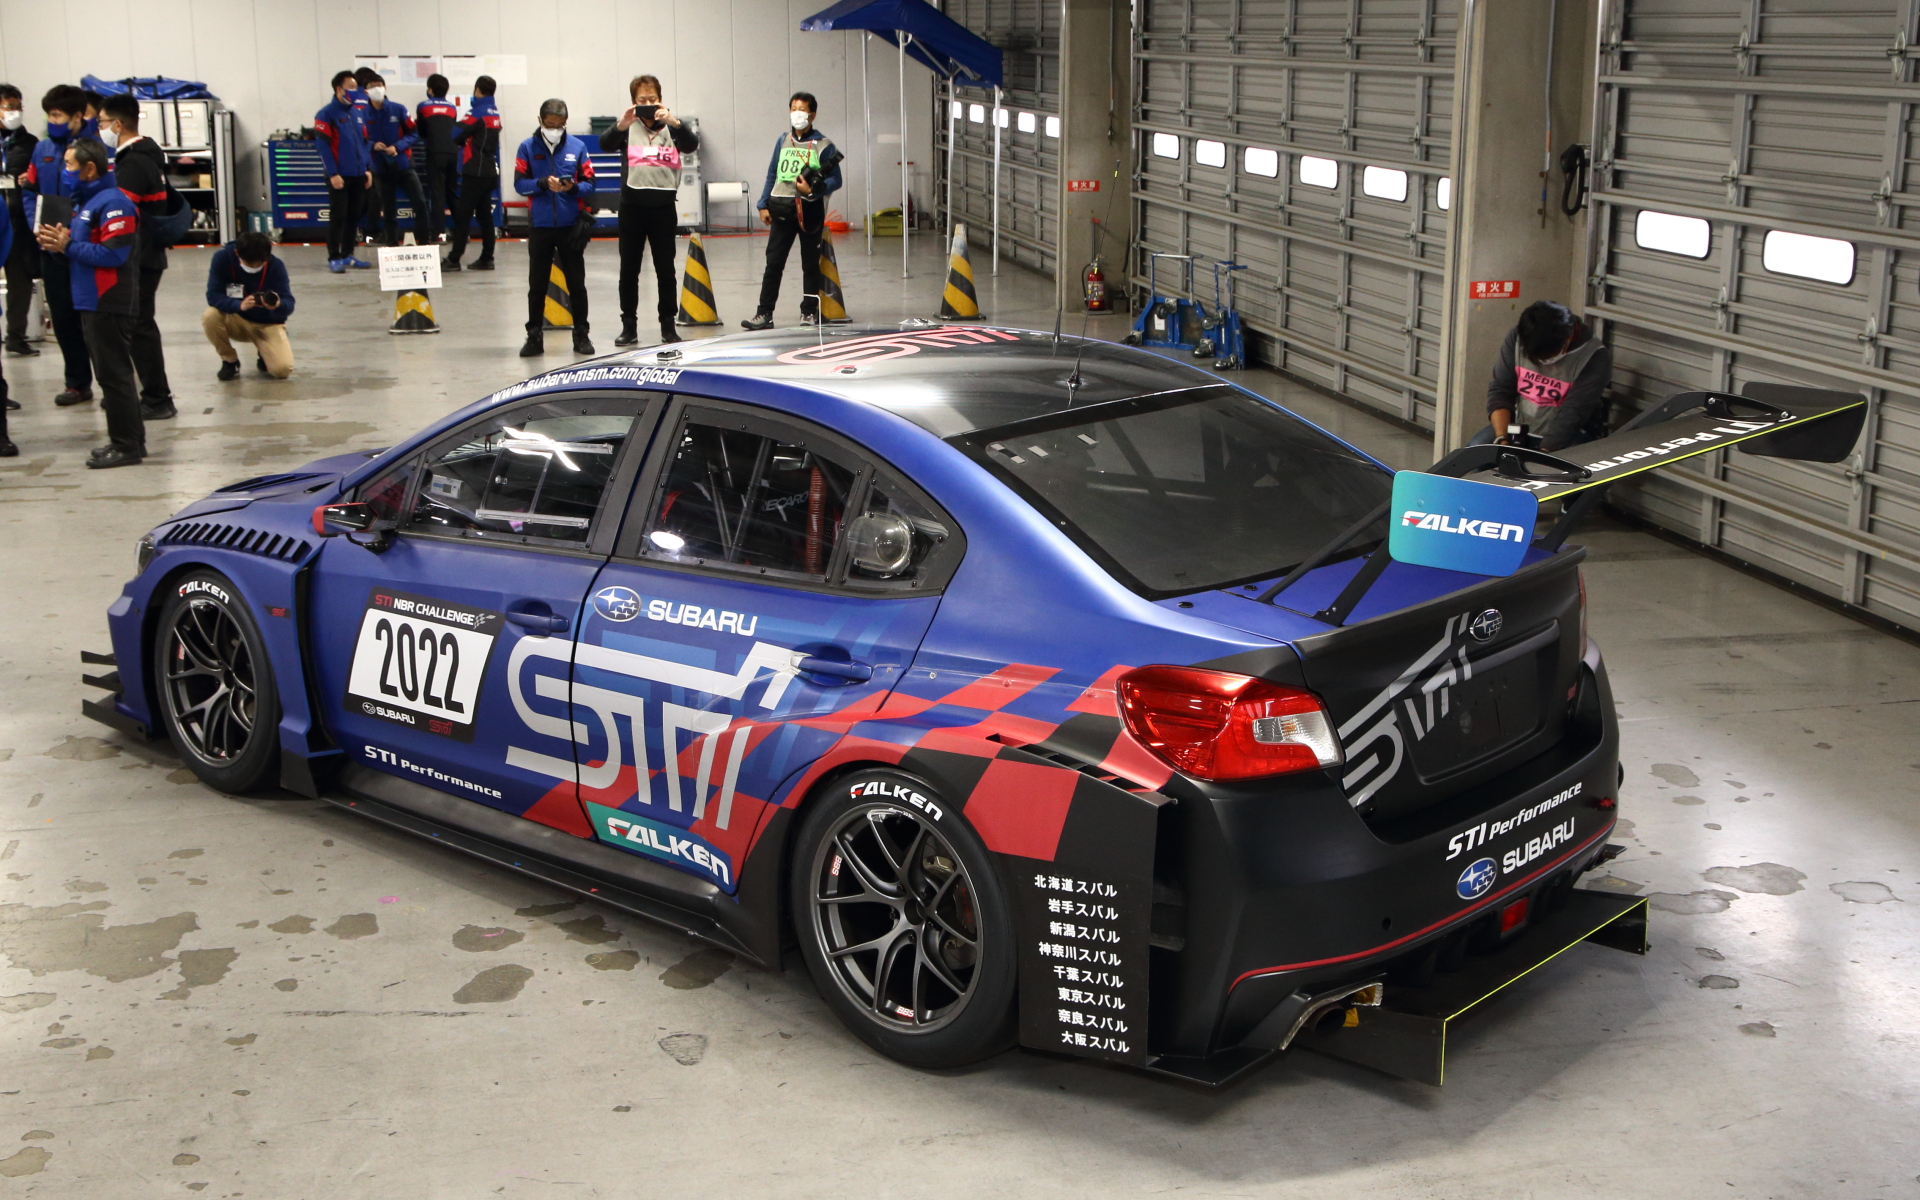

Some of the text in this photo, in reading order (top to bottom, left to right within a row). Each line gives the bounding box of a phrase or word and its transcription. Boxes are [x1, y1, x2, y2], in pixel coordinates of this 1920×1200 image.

[1476, 282, 1513, 293] 消火器
[1519, 379, 1562, 402] 219
[1524, 371, 1562, 390] MEDIA
[1400, 510, 1524, 542] FALKEN
[178, 581, 230, 604] FALKEN
[375, 594, 476, 626] STI NBR CHALLENGE
[647, 600, 758, 637] SUBARU
[375, 618, 465, 715] 2022
[376, 706, 415, 725] SUBARU
[365, 744, 503, 800] STI Performance
[849, 781, 943, 821] FALKEN
[1446, 782, 1583, 861] STI Performance
[606, 816, 730, 886] FALKEN
[1502, 816, 1576, 875] SUBARU
[831, 854, 842, 877] BBS
[1034, 874, 1118, 898] 北海道スバル
[1048, 898, 1119, 921] 岩手スバル
[1050, 921, 1120, 944] 新潟スバル
[1038, 942, 1122, 967] 神奈川スバル
[1053, 965, 1124, 989] 千葉スバル
[1058, 987, 1126, 1010] 東京スバル
[896, 1005, 915, 1018] BBS
[1058, 1009, 1128, 1033] 奈良スバル
[1061, 1031, 1130, 1054] 大阪スバル
